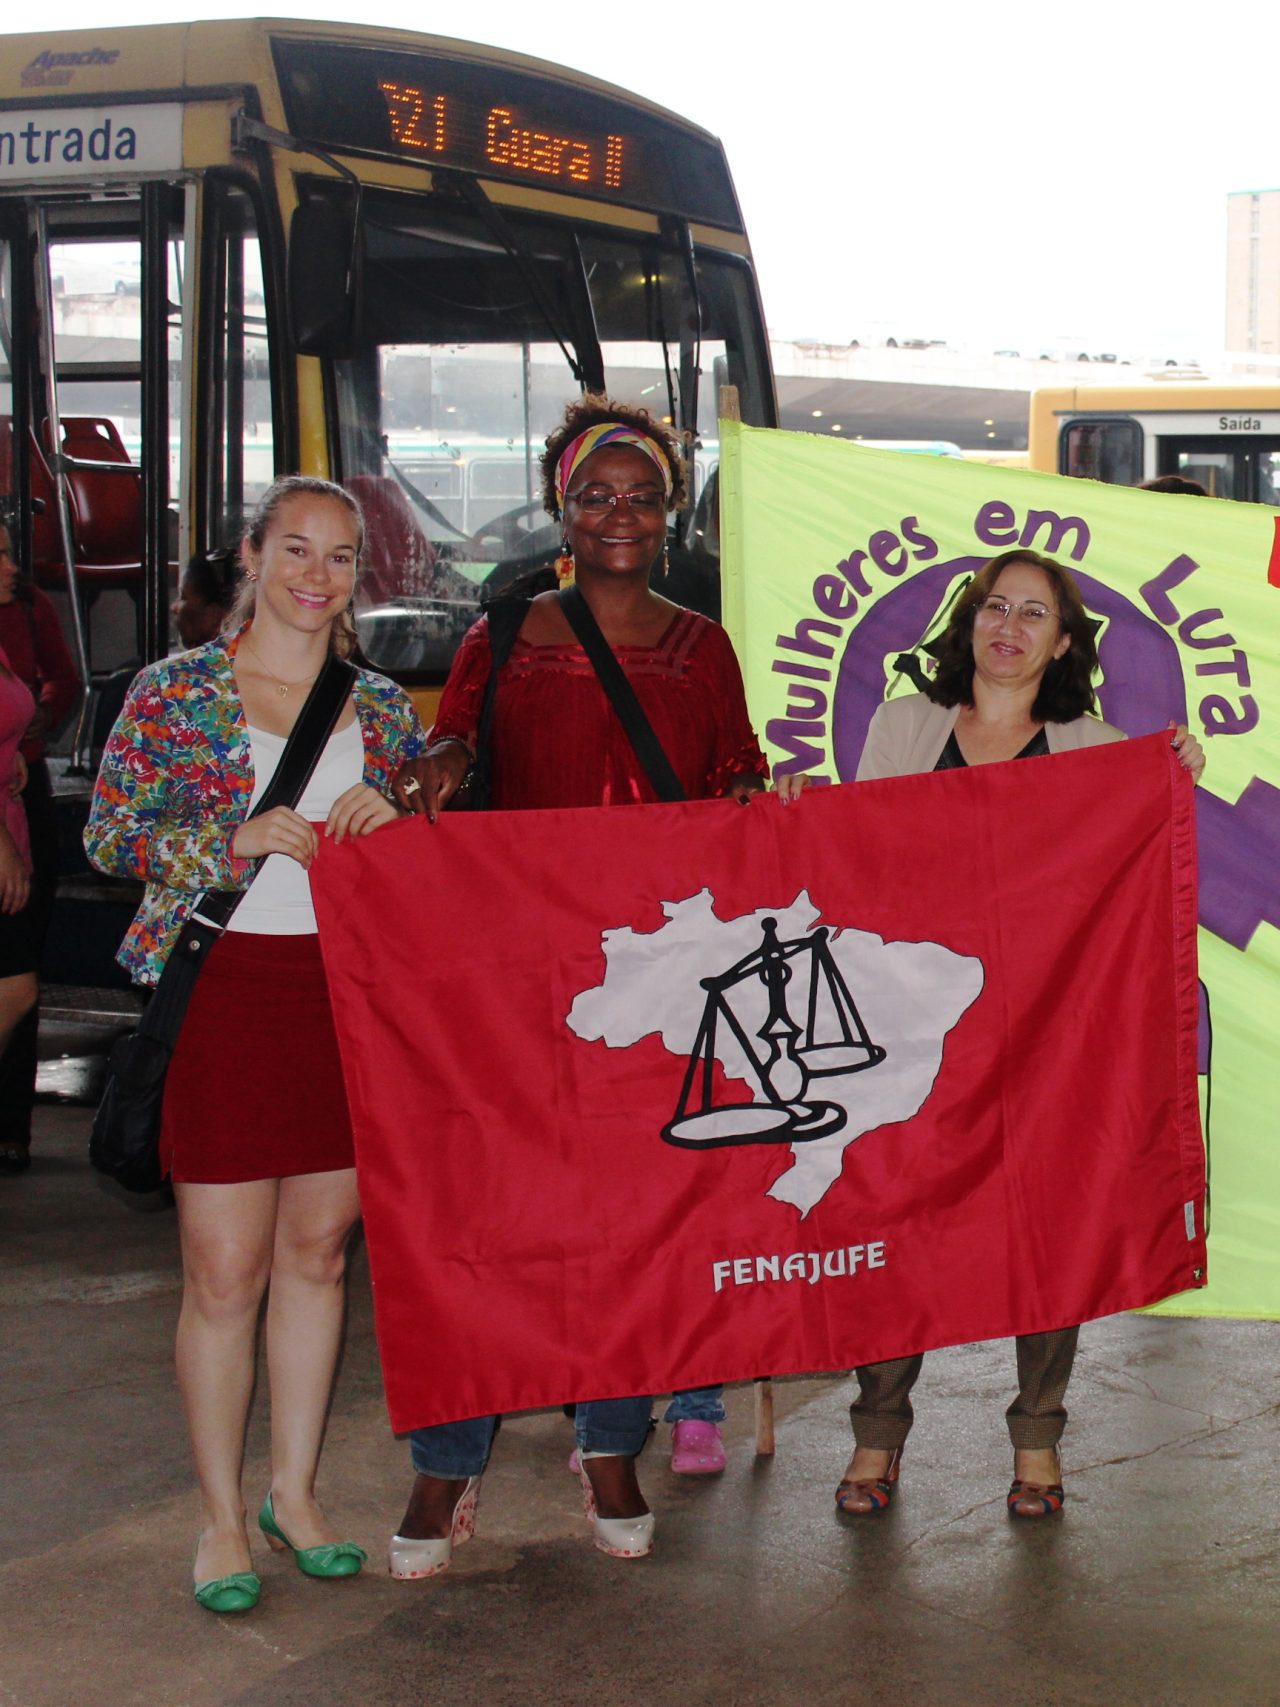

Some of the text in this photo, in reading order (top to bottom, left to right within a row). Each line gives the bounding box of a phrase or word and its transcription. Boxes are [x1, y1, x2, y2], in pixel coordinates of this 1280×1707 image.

[1219, 415, 1261, 430] Saída
[974, 500, 1091, 562] em
[713, 1240, 886, 1293] FENAJUFE
